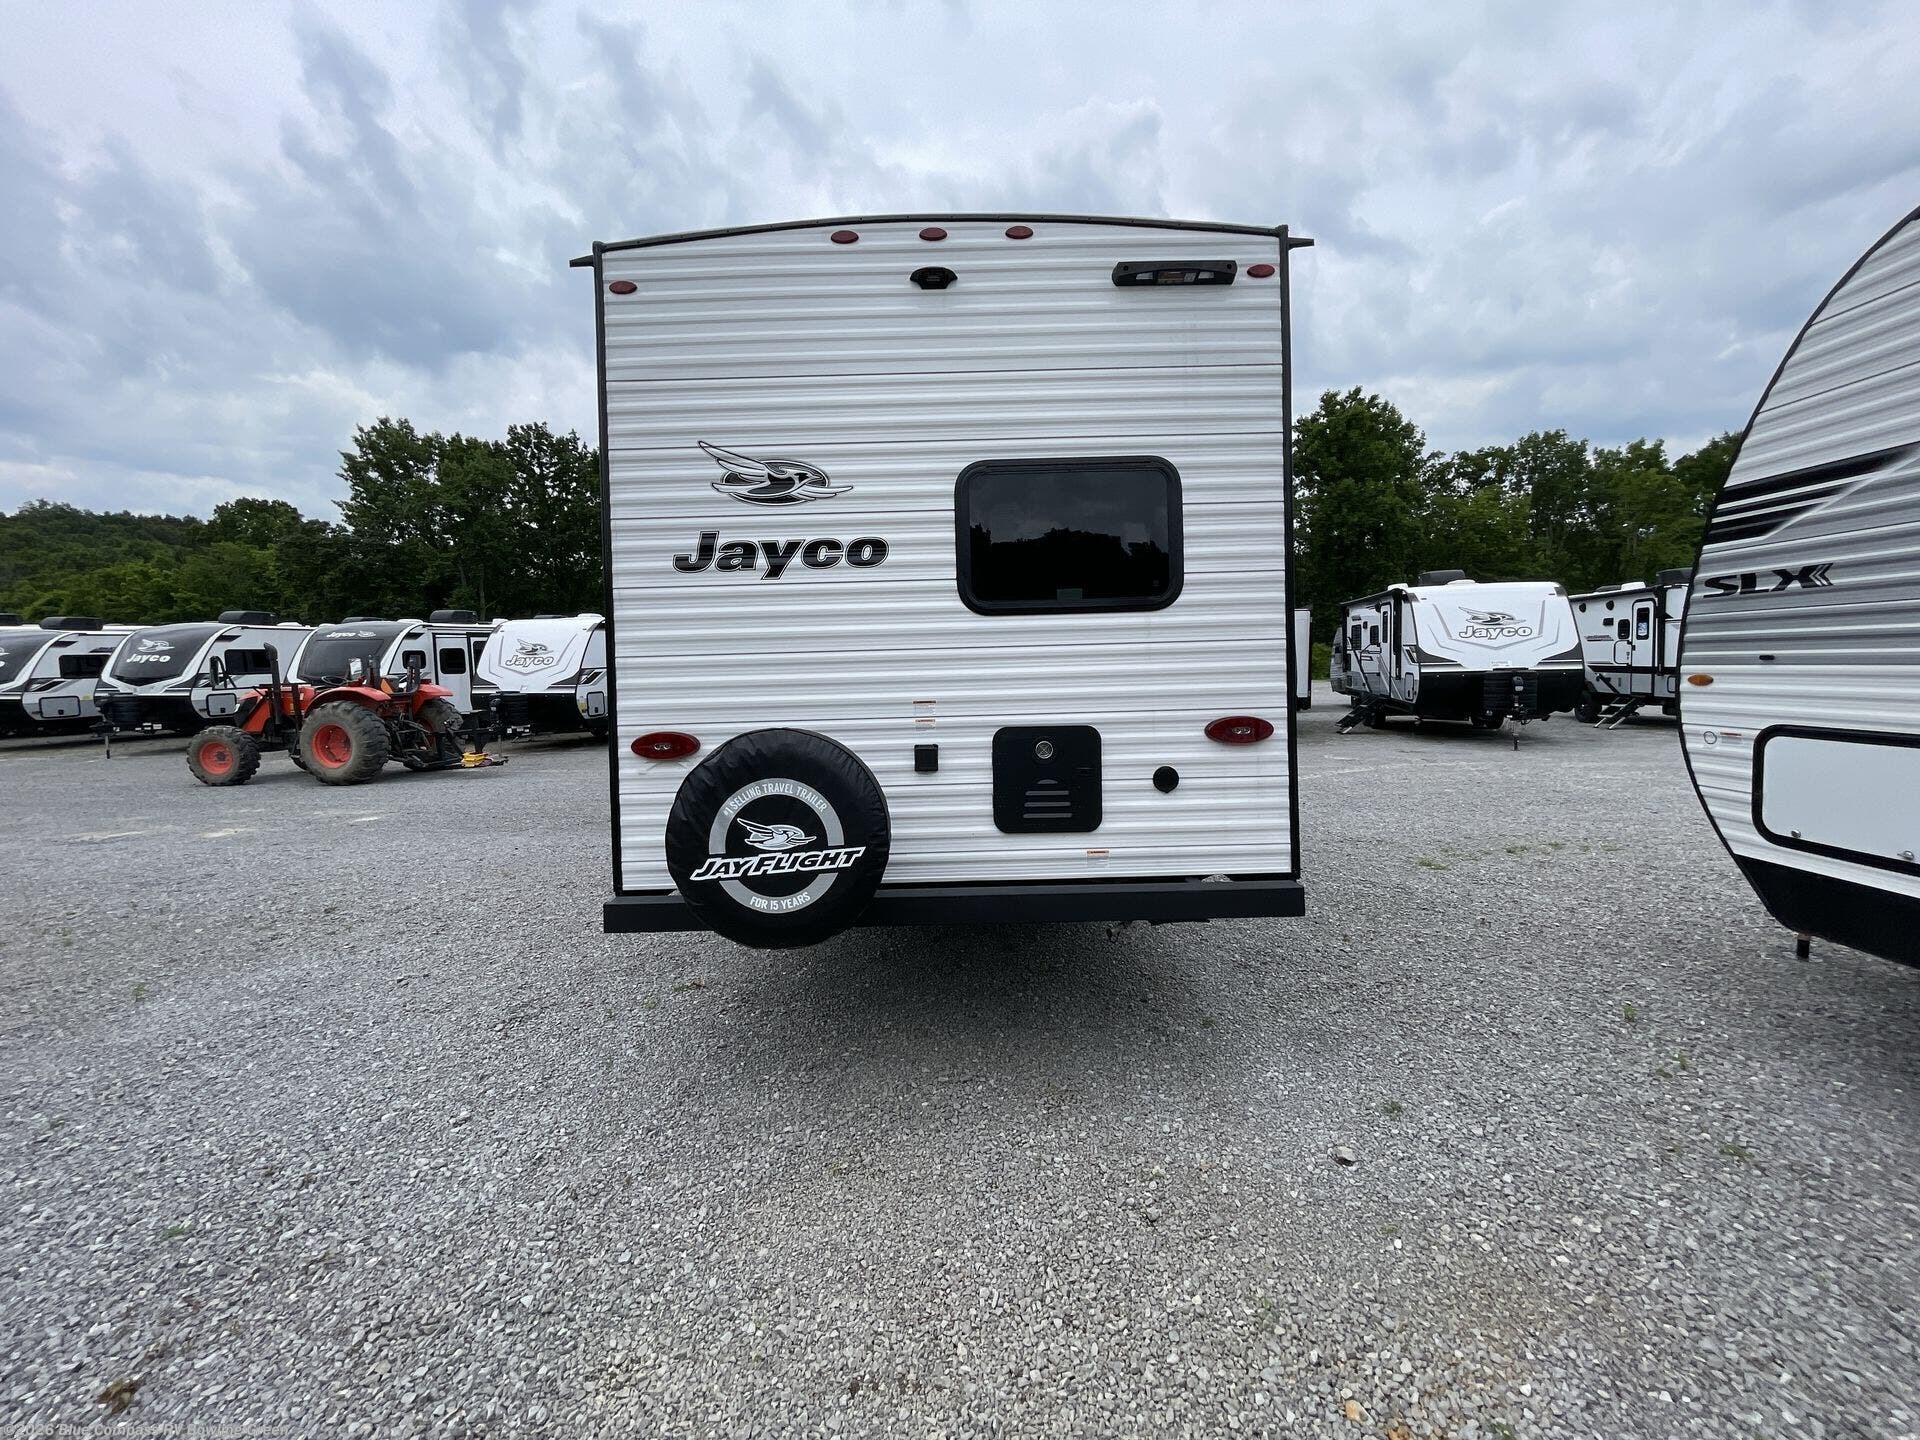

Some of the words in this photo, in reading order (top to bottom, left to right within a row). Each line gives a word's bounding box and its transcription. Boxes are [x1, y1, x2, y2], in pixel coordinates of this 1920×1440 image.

[673, 530, 890, 581] Jayco
[1703, 563, 1834, 598] SLX
[1459, 626, 1533, 640] Jayco
[126, 653, 171, 664] Jayco
[505, 655, 555, 667] Jayco
[730, 785, 761, 811] SELLING
[762, 782, 794, 794] TRAVEL
[796, 786, 828, 813] TRAILER
[749, 895, 768, 910] FOR
[770, 900, 779, 911] 15
[780, 891, 811, 910] YEARS
